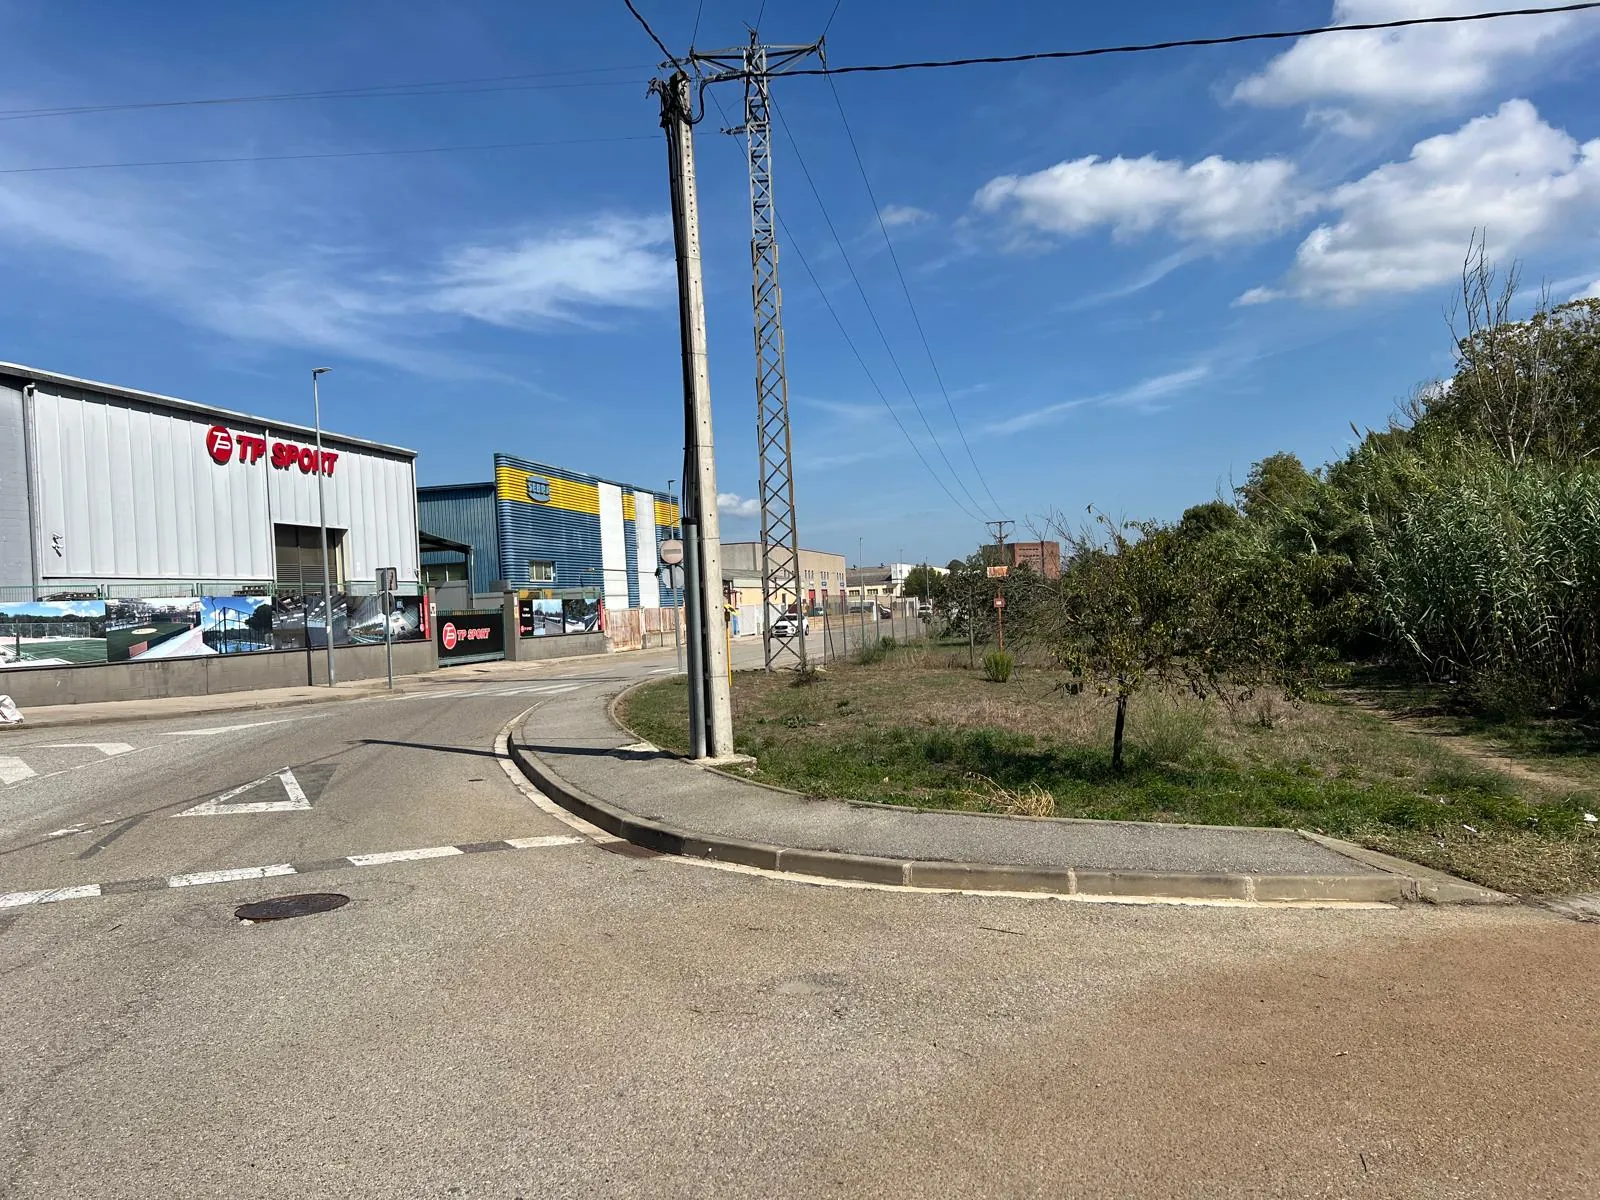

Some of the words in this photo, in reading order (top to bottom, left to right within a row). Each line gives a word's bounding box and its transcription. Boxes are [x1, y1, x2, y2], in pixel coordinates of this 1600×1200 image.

[236, 434, 266, 465] TP
[270, 442, 339, 478] SPORT
[457, 629, 467, 641] TP
[467, 627, 491, 640] SPORT
